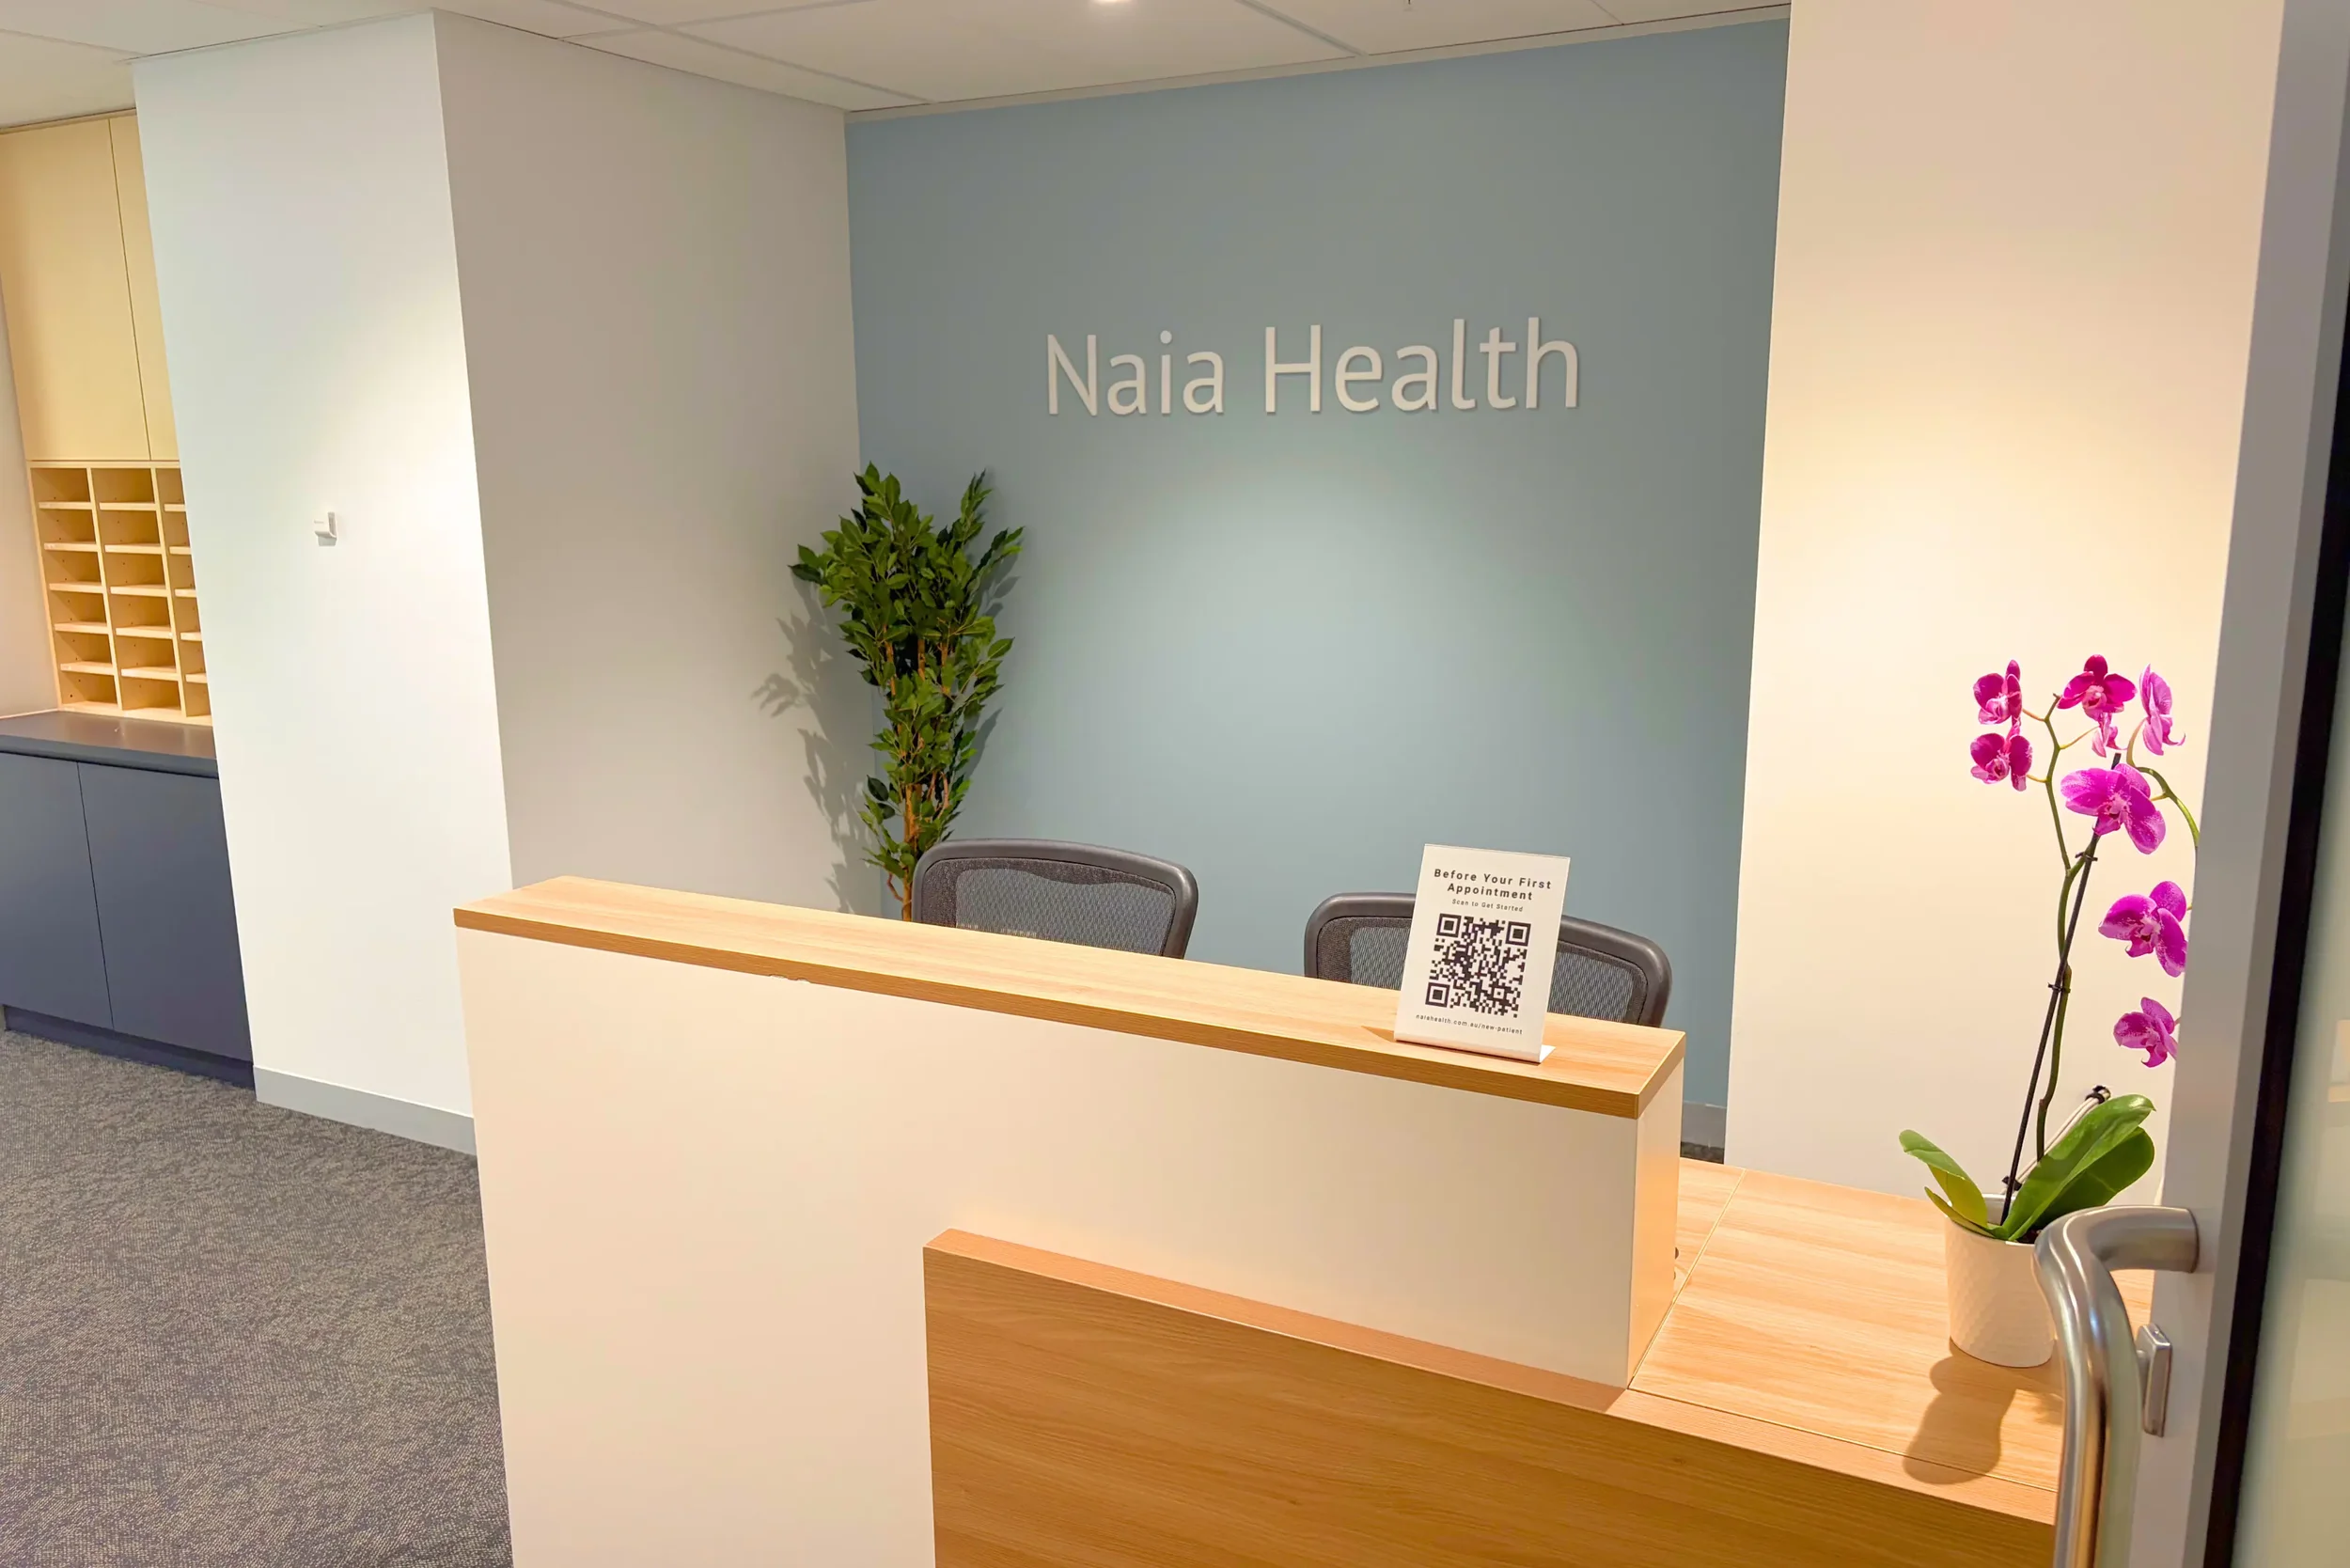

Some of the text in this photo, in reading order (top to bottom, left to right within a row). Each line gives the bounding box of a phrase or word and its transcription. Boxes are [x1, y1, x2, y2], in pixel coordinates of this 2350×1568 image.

[1046, 317, 1579, 416] Naia Health
[1434, 869, 1552, 889] Before Your First
[1447, 883, 1533, 901] Appointment
[1496, 903, 1524, 912] Started
[1416, 1013, 1523, 1035] naiahealth.com.au/new-patient
